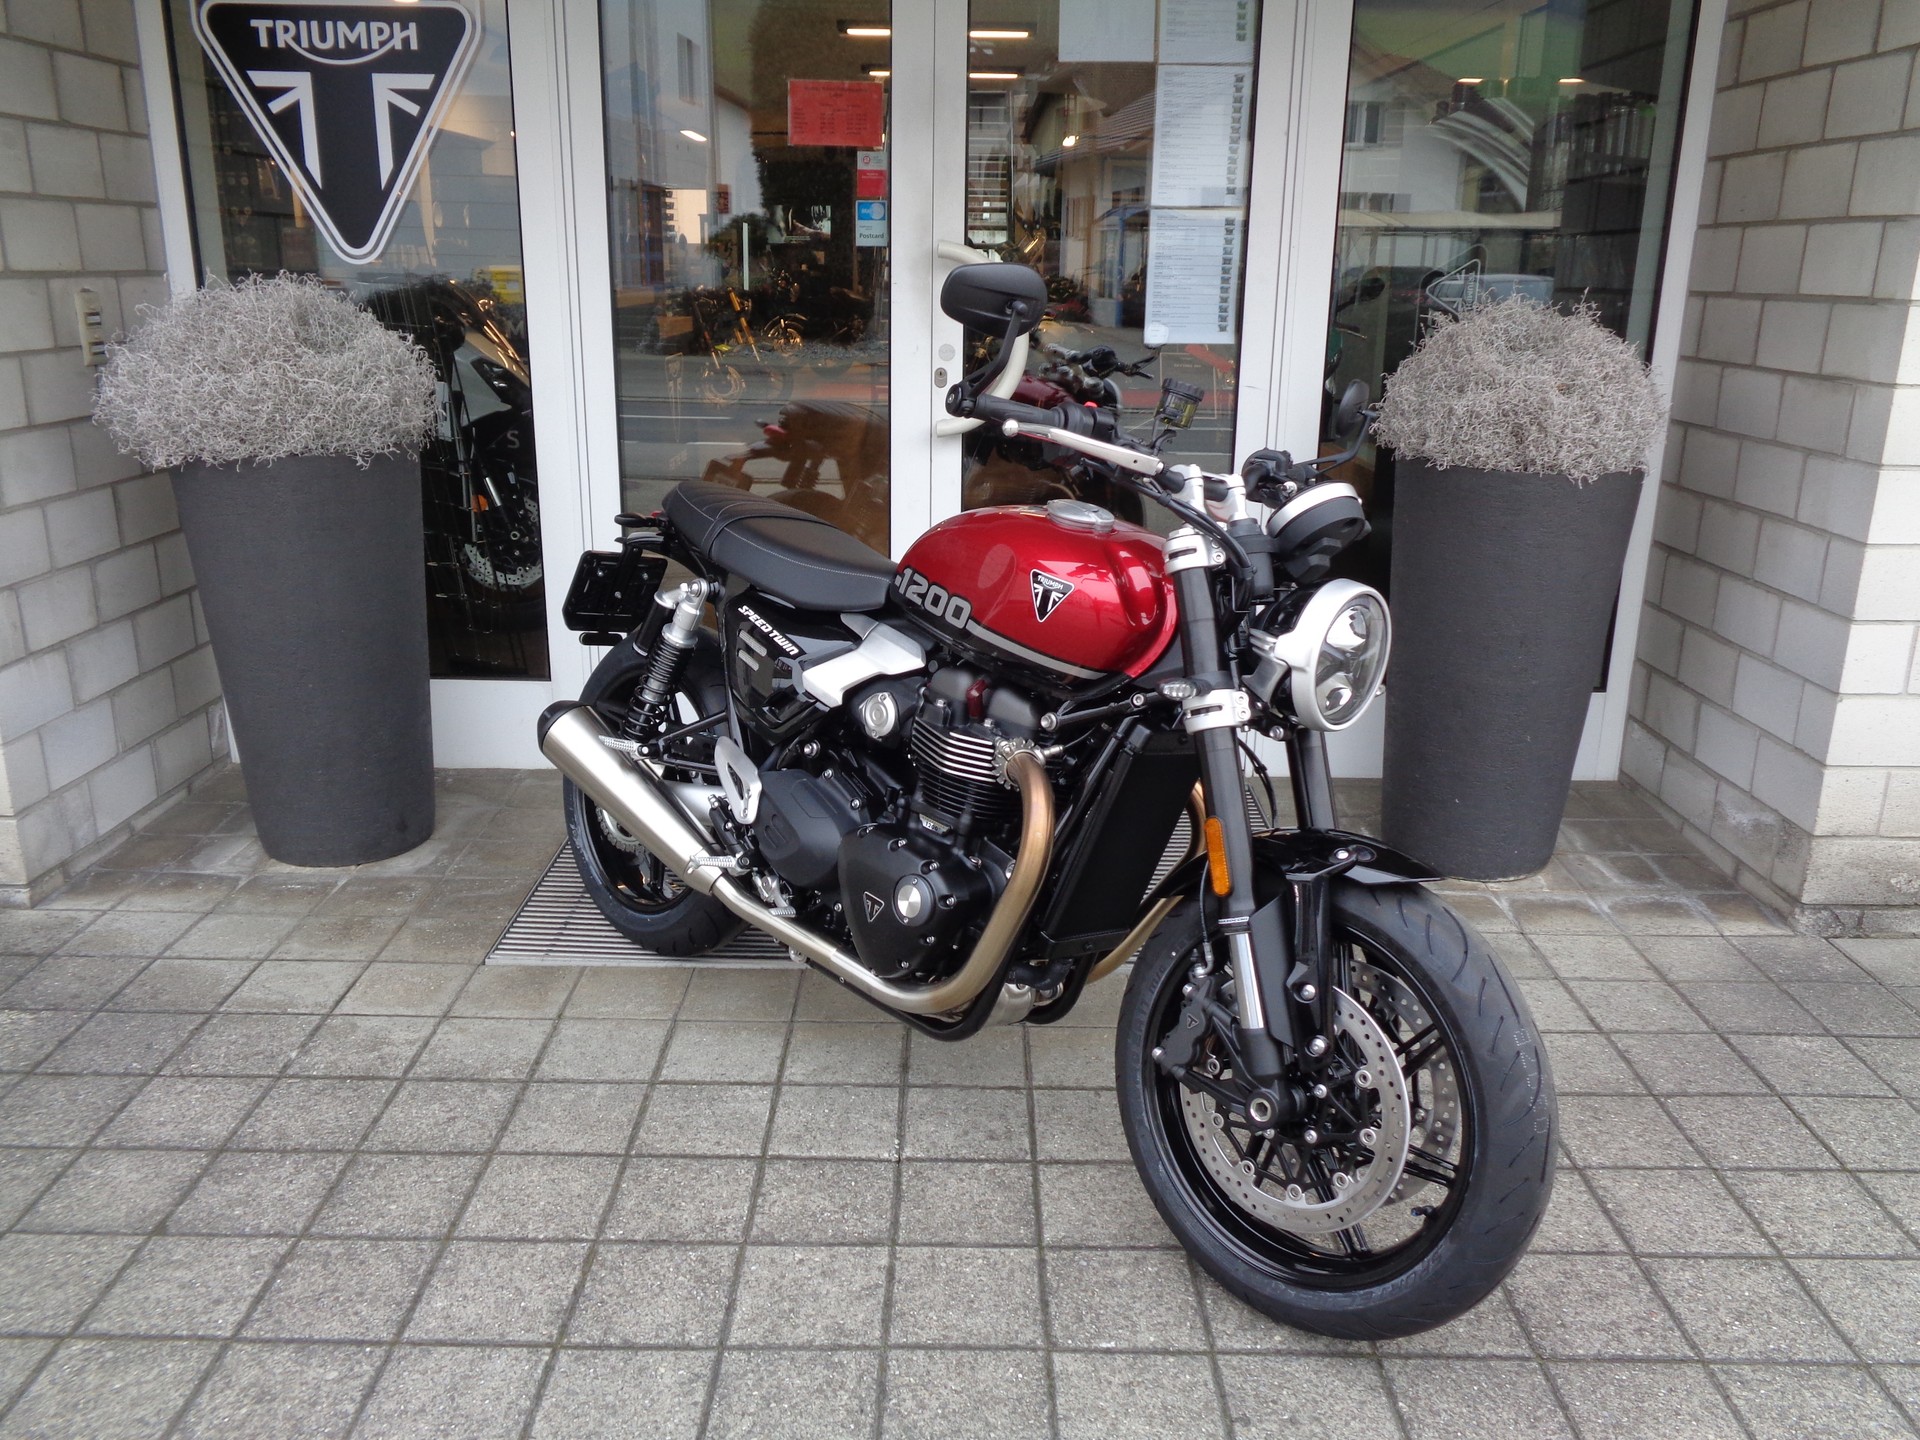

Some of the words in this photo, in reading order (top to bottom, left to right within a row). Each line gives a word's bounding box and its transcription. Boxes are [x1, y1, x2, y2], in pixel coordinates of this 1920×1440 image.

[249, 19, 419, 65] TRIUMPH
[898, 568, 972, 630] 1200
[1037, 575, 1064, 590] TRIUMPH
[738, 605, 773, 633] SPEED
[768, 629, 799, 656] TWIN
